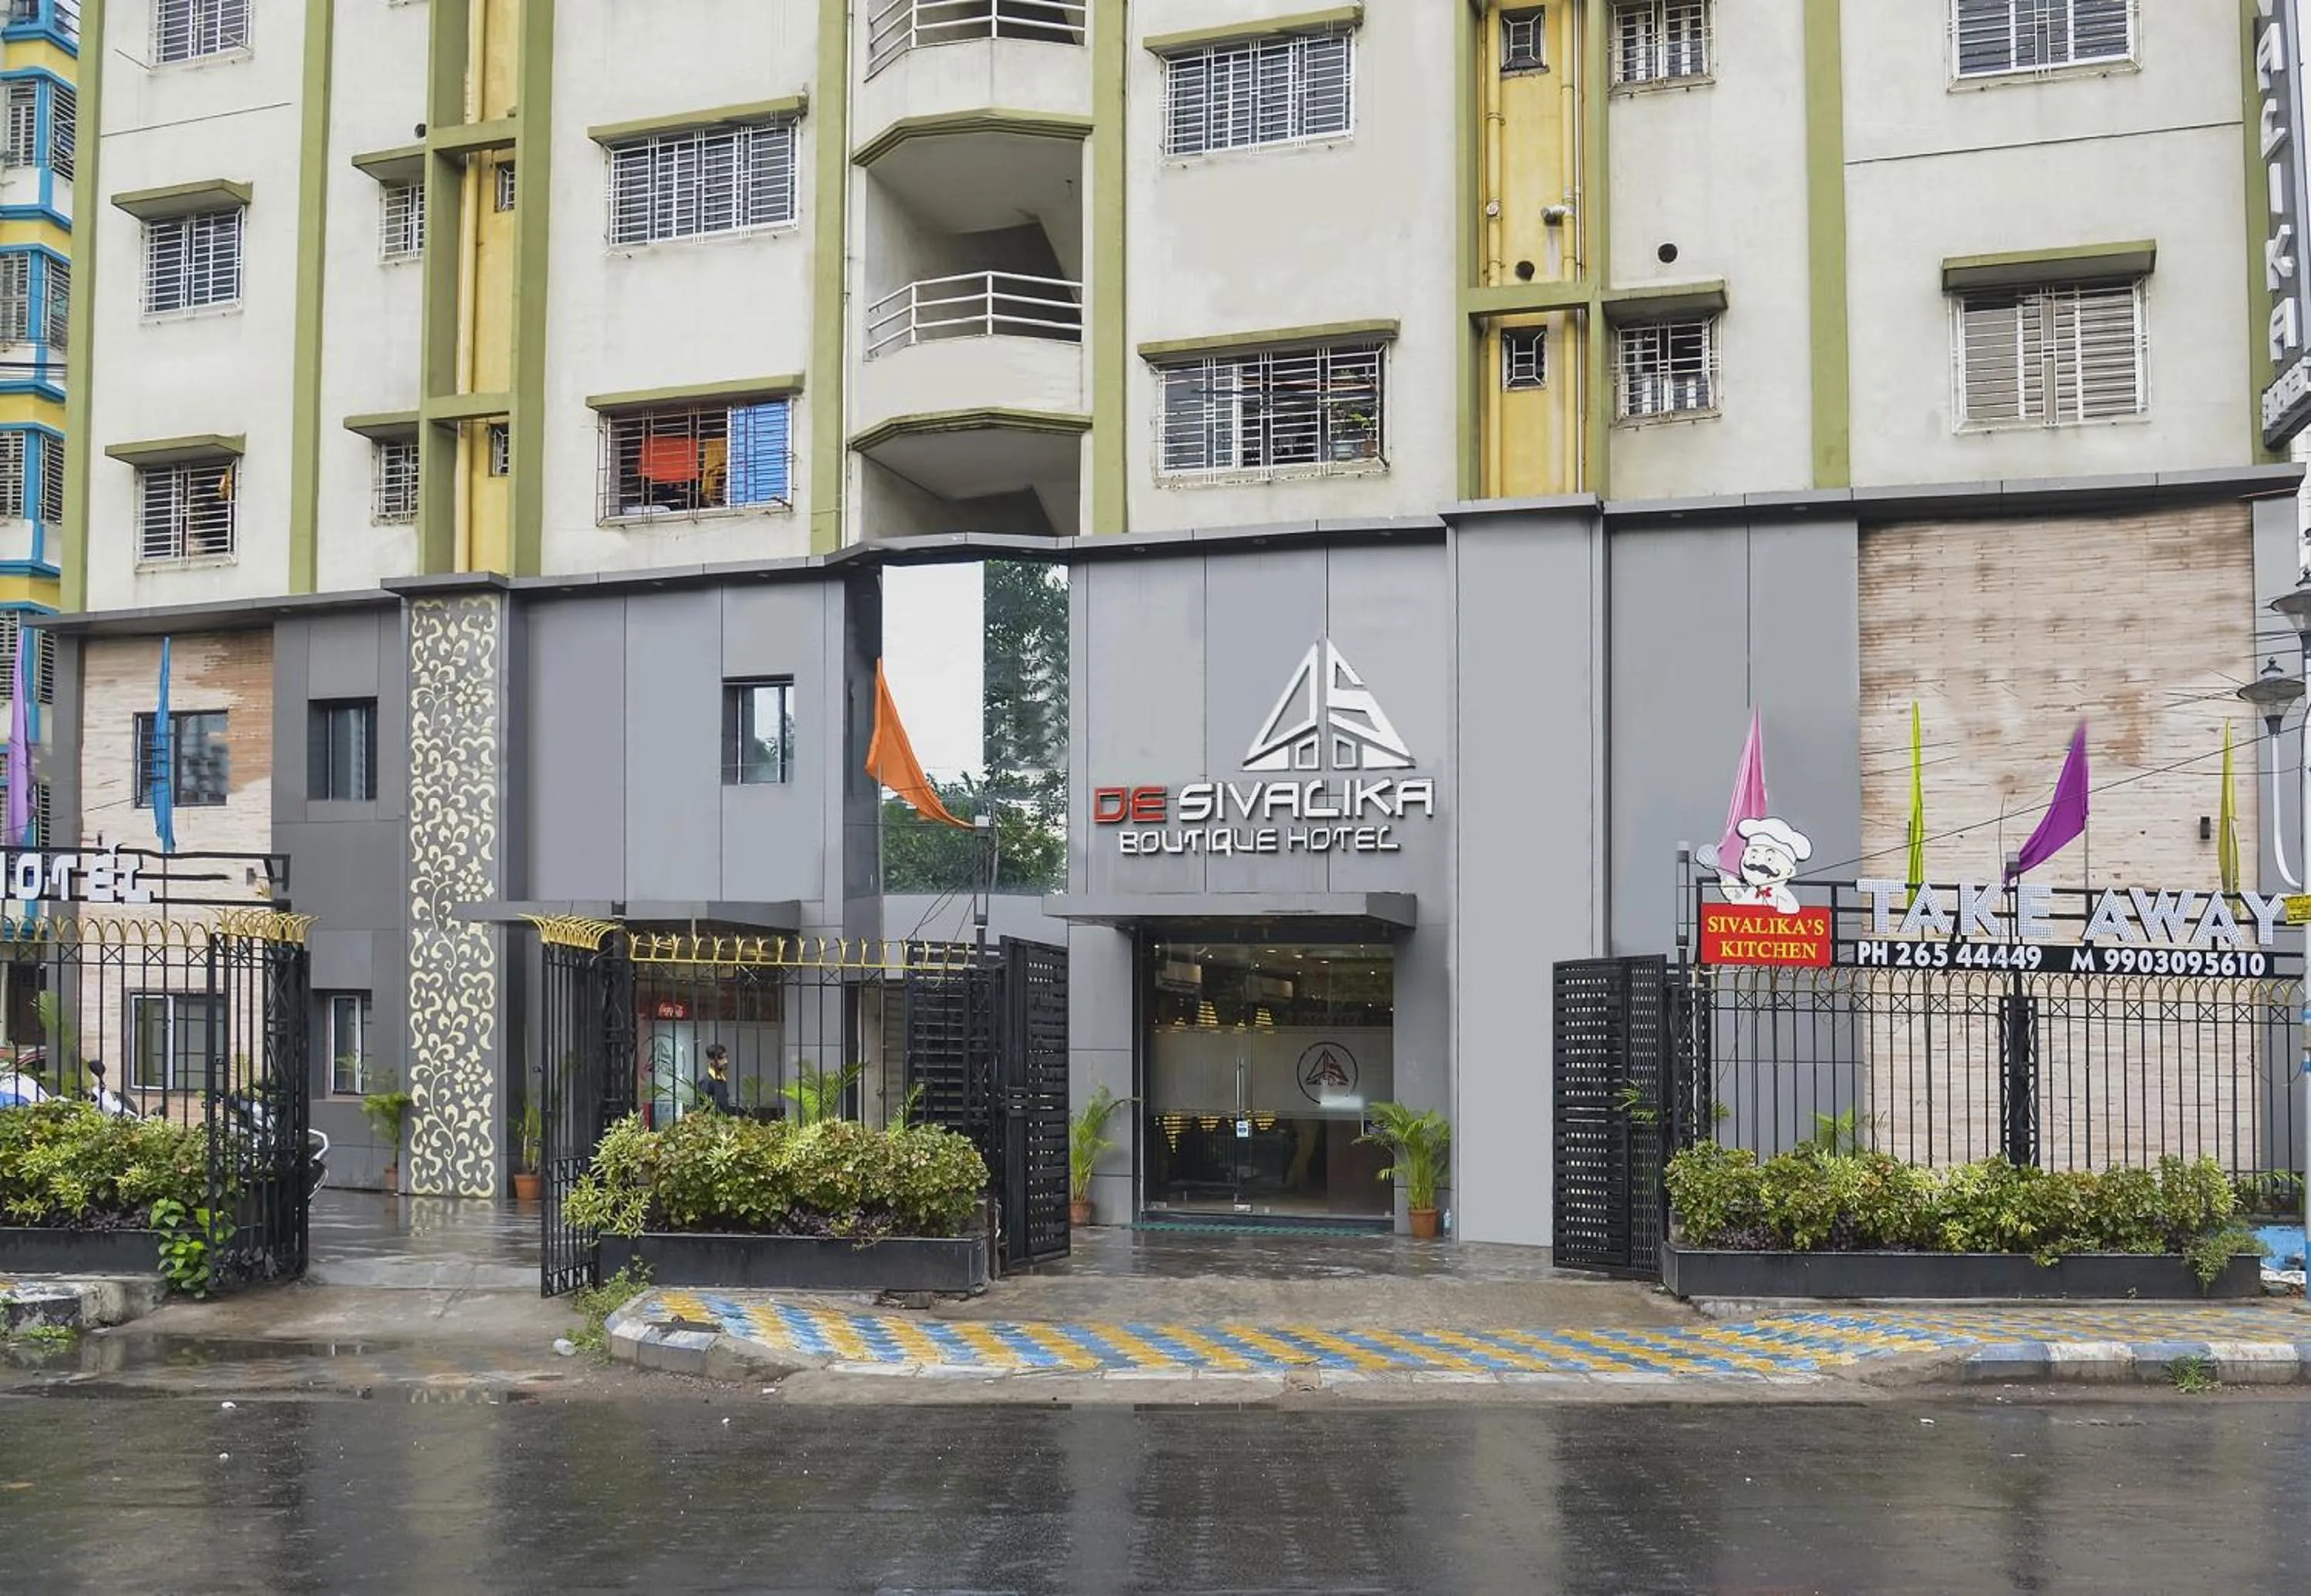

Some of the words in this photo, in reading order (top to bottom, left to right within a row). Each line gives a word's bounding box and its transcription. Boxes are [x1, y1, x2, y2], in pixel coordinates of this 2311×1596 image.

[1093, 786, 1166, 823] DE
[1178, 778, 1434, 821] SIVALIKA
[1119, 828, 1277, 857] BOUTIQUE
[1287, 826, 1401, 851] HOTEL
[1707, 914, 1825, 937] SIVALIKA'S
[1855, 879, 2054, 937] TAKE
[2081, 887, 2286, 945] AWAY
[1719, 940, 1818, 959] KITCHEN
[1857, 940, 1888, 965] PH
[1895, 942, 1948, 967] 265
[1955, 944, 2043, 971] 44449
[2070, 947, 2095, 972] M
[2104, 947, 2266, 977] 9903095610
